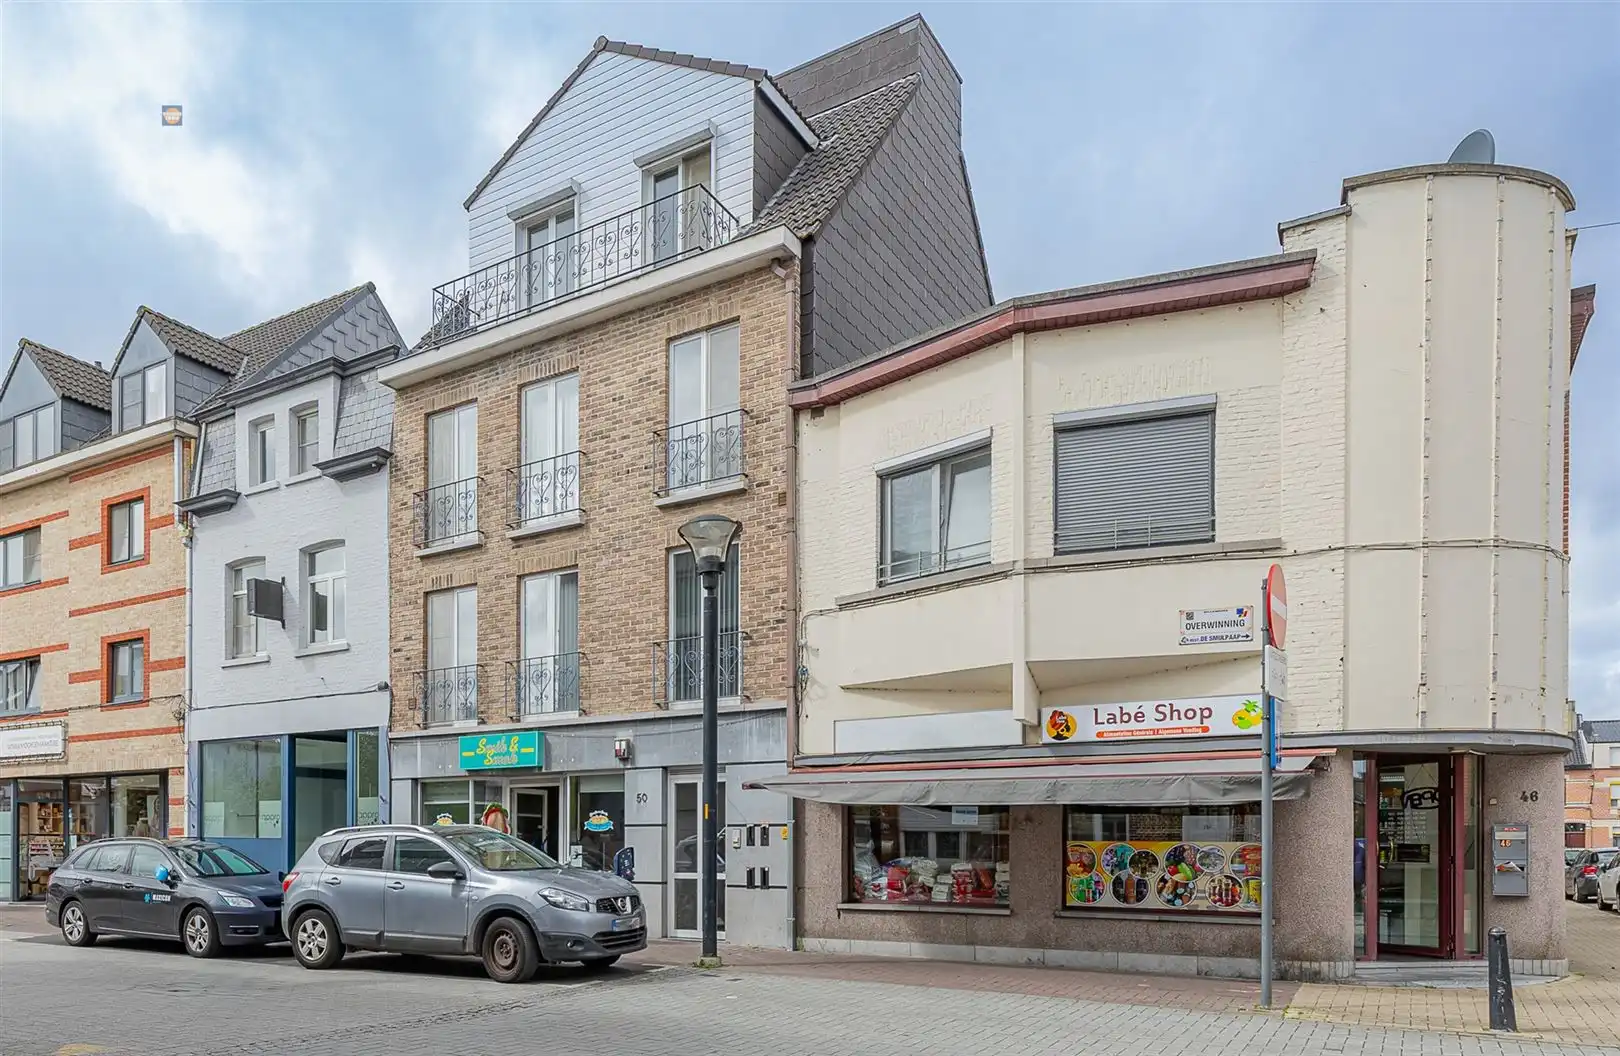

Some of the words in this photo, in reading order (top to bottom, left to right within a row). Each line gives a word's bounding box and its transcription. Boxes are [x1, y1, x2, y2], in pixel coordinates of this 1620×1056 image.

[1185, 619, 1245, 631] OVERWINNING
[1093, 704, 1146, 726] Labé
[1154, 703, 1214, 725] Shop
[509, 735, 519, 752] &
[636, 792, 648, 804] 50
[1520, 790, 1539, 803] 46
[1499, 839, 1512, 848] 46
